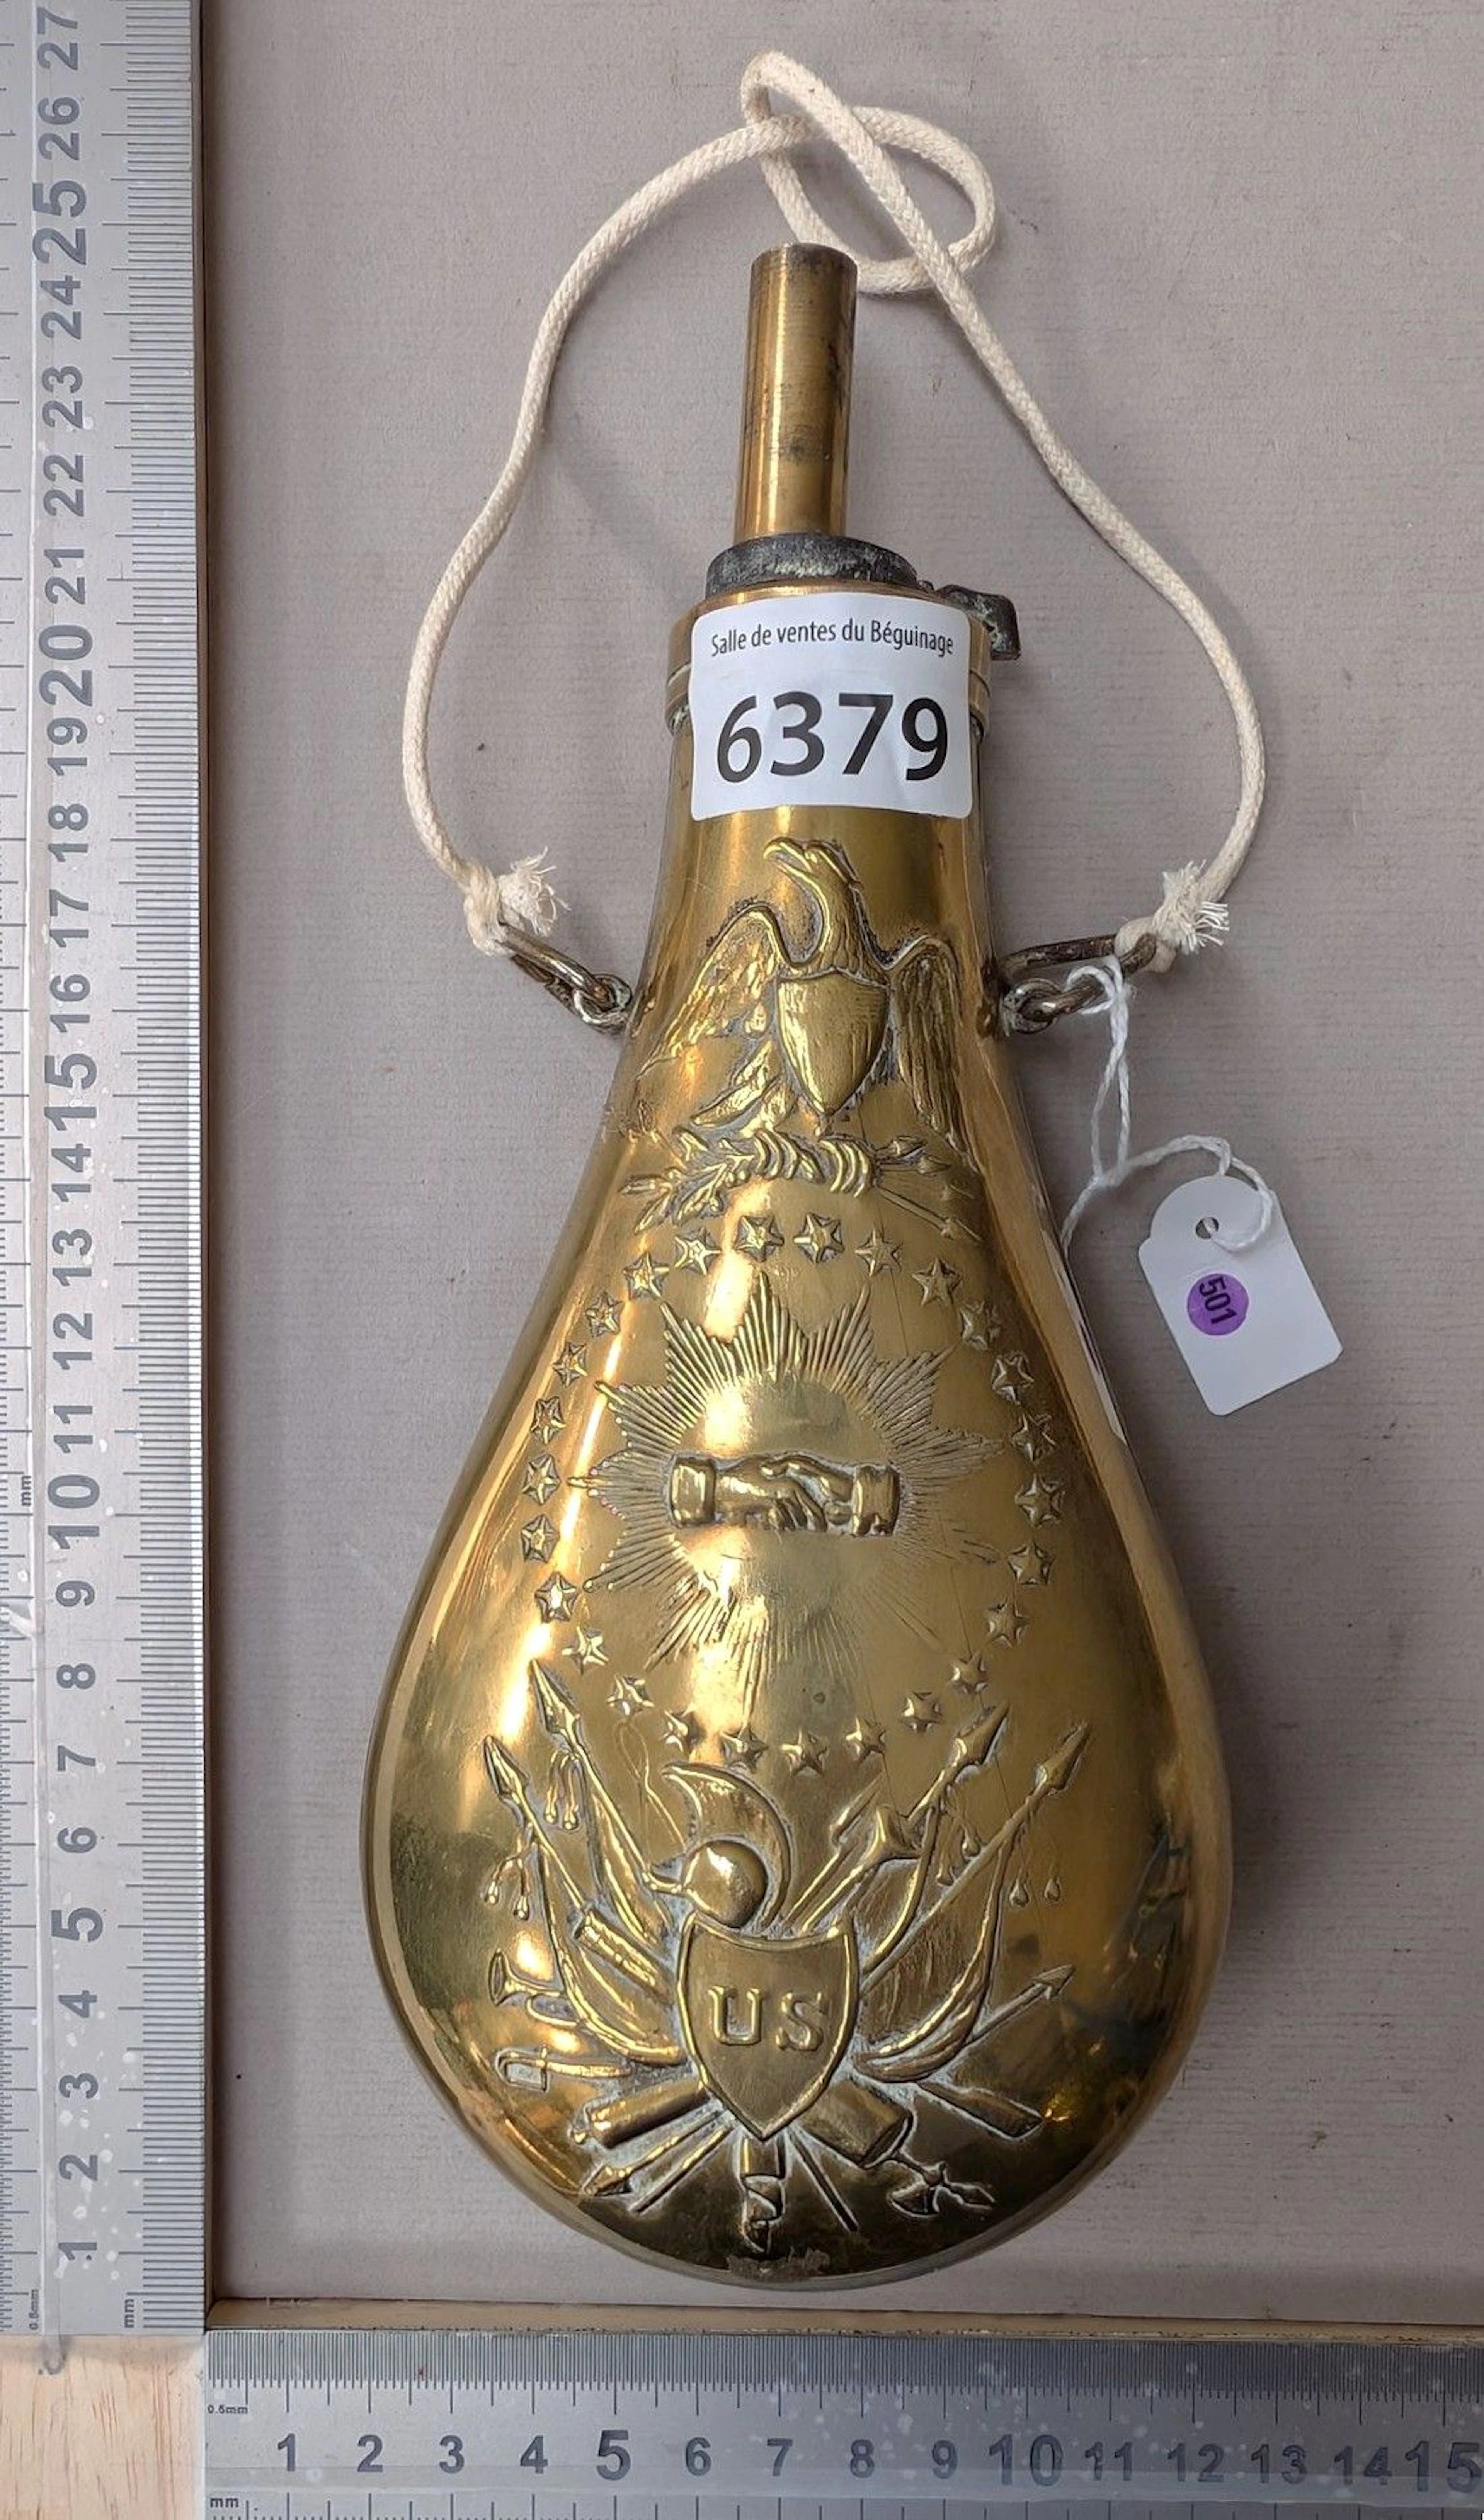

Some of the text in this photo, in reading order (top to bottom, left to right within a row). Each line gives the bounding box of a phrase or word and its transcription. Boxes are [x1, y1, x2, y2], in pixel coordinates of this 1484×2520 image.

[711, 617, 954, 658] Salle de ventes du Béguinage
[716, 691, 948, 783] 6379
[32, 7, 103, 2260] 1 2 3 4 5 6 7 8 9 10 11 12 13 14 15 16 17 18 19 20 21 22 23 24 25 26 27
[1199, 1276, 1237, 1325] 501
[20, 1475, 31, 1507] mm
[124, 2299, 135, 2328] mm
[277, 2429, 1482, 2493] 1 2 3 4 5 6 7 8 9 10 11 12 13 14 15
[209, 2496, 239, 2508] mm
